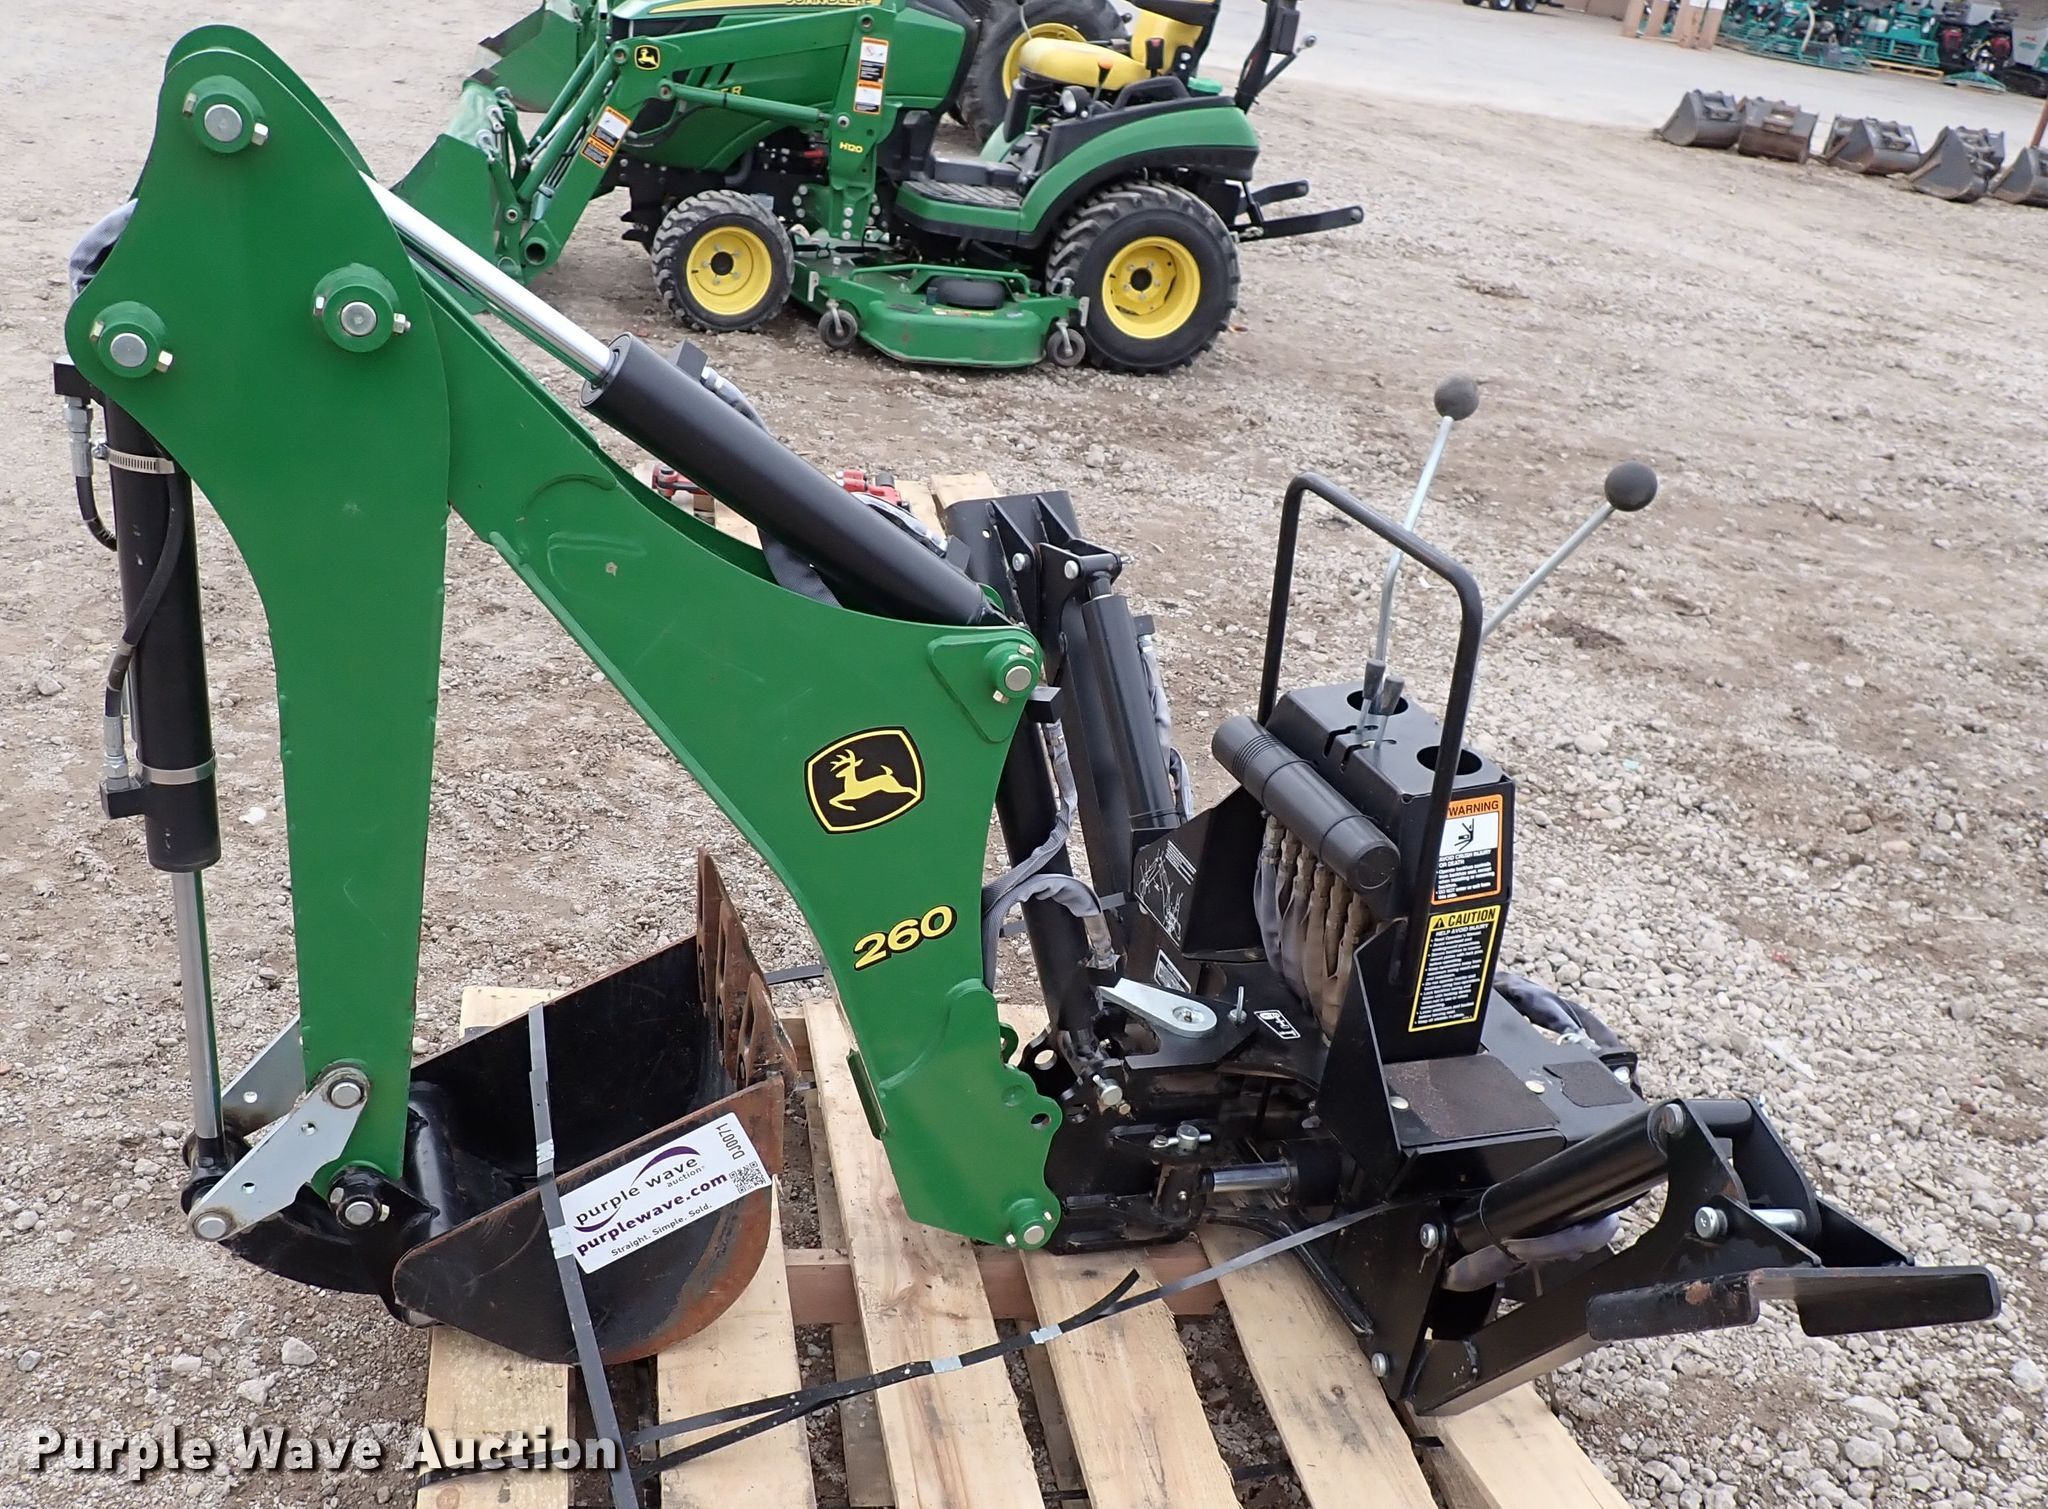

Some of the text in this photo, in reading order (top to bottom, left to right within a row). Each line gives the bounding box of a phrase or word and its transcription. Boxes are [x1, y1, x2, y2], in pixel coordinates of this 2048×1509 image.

[1449, 801, 1499, 816] WARNING
[854, 905, 956, 970] 260
[1448, 908, 1496, 926] CAUTION
[716, 1122, 745, 1160] DJ0071
[576, 1158, 698, 1225] purple wave
[667, 1168, 702, 1188] auction
[576, 1174, 728, 1256] purplewave.com
[611, 1203, 712, 1256] Straight. Simple. Sold.
